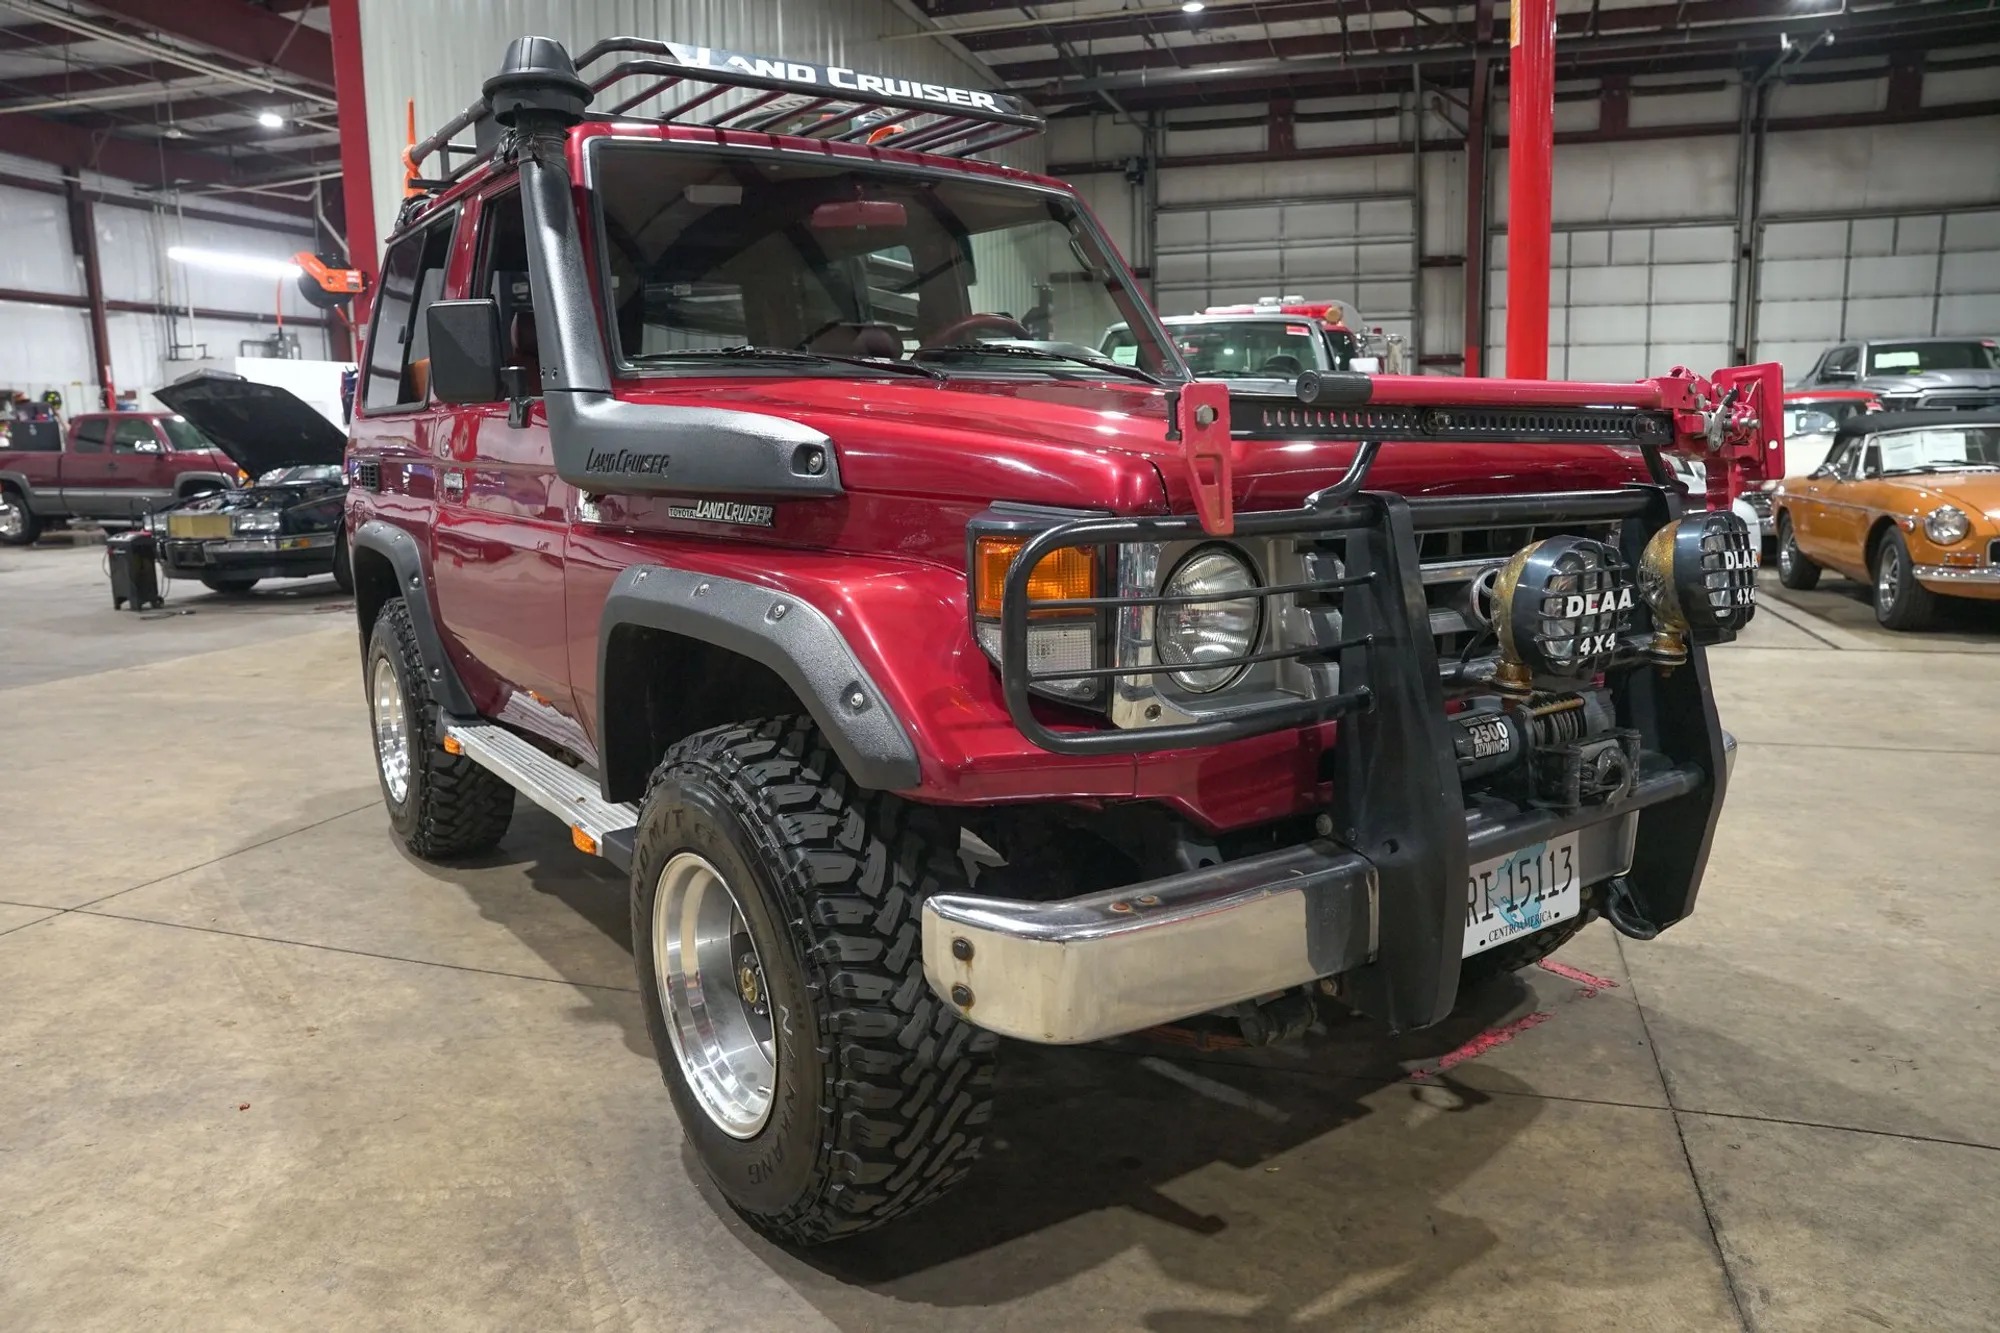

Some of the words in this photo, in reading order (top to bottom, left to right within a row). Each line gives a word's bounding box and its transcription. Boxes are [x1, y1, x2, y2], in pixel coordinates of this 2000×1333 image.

[827, 66, 1005, 113] CRUISER
[1724, 551, 1759, 570] DLAA
[1566, 588, 1634, 618] DLAA
[1736, 587, 1757, 605] 4X4
[1579, 633, 1616, 656] 4X4
[1469, 721, 1509, 745] 2500
[1506, 845, 1573, 914] 15113
[1488, 909, 1553, 943] CENTROAMERICA
